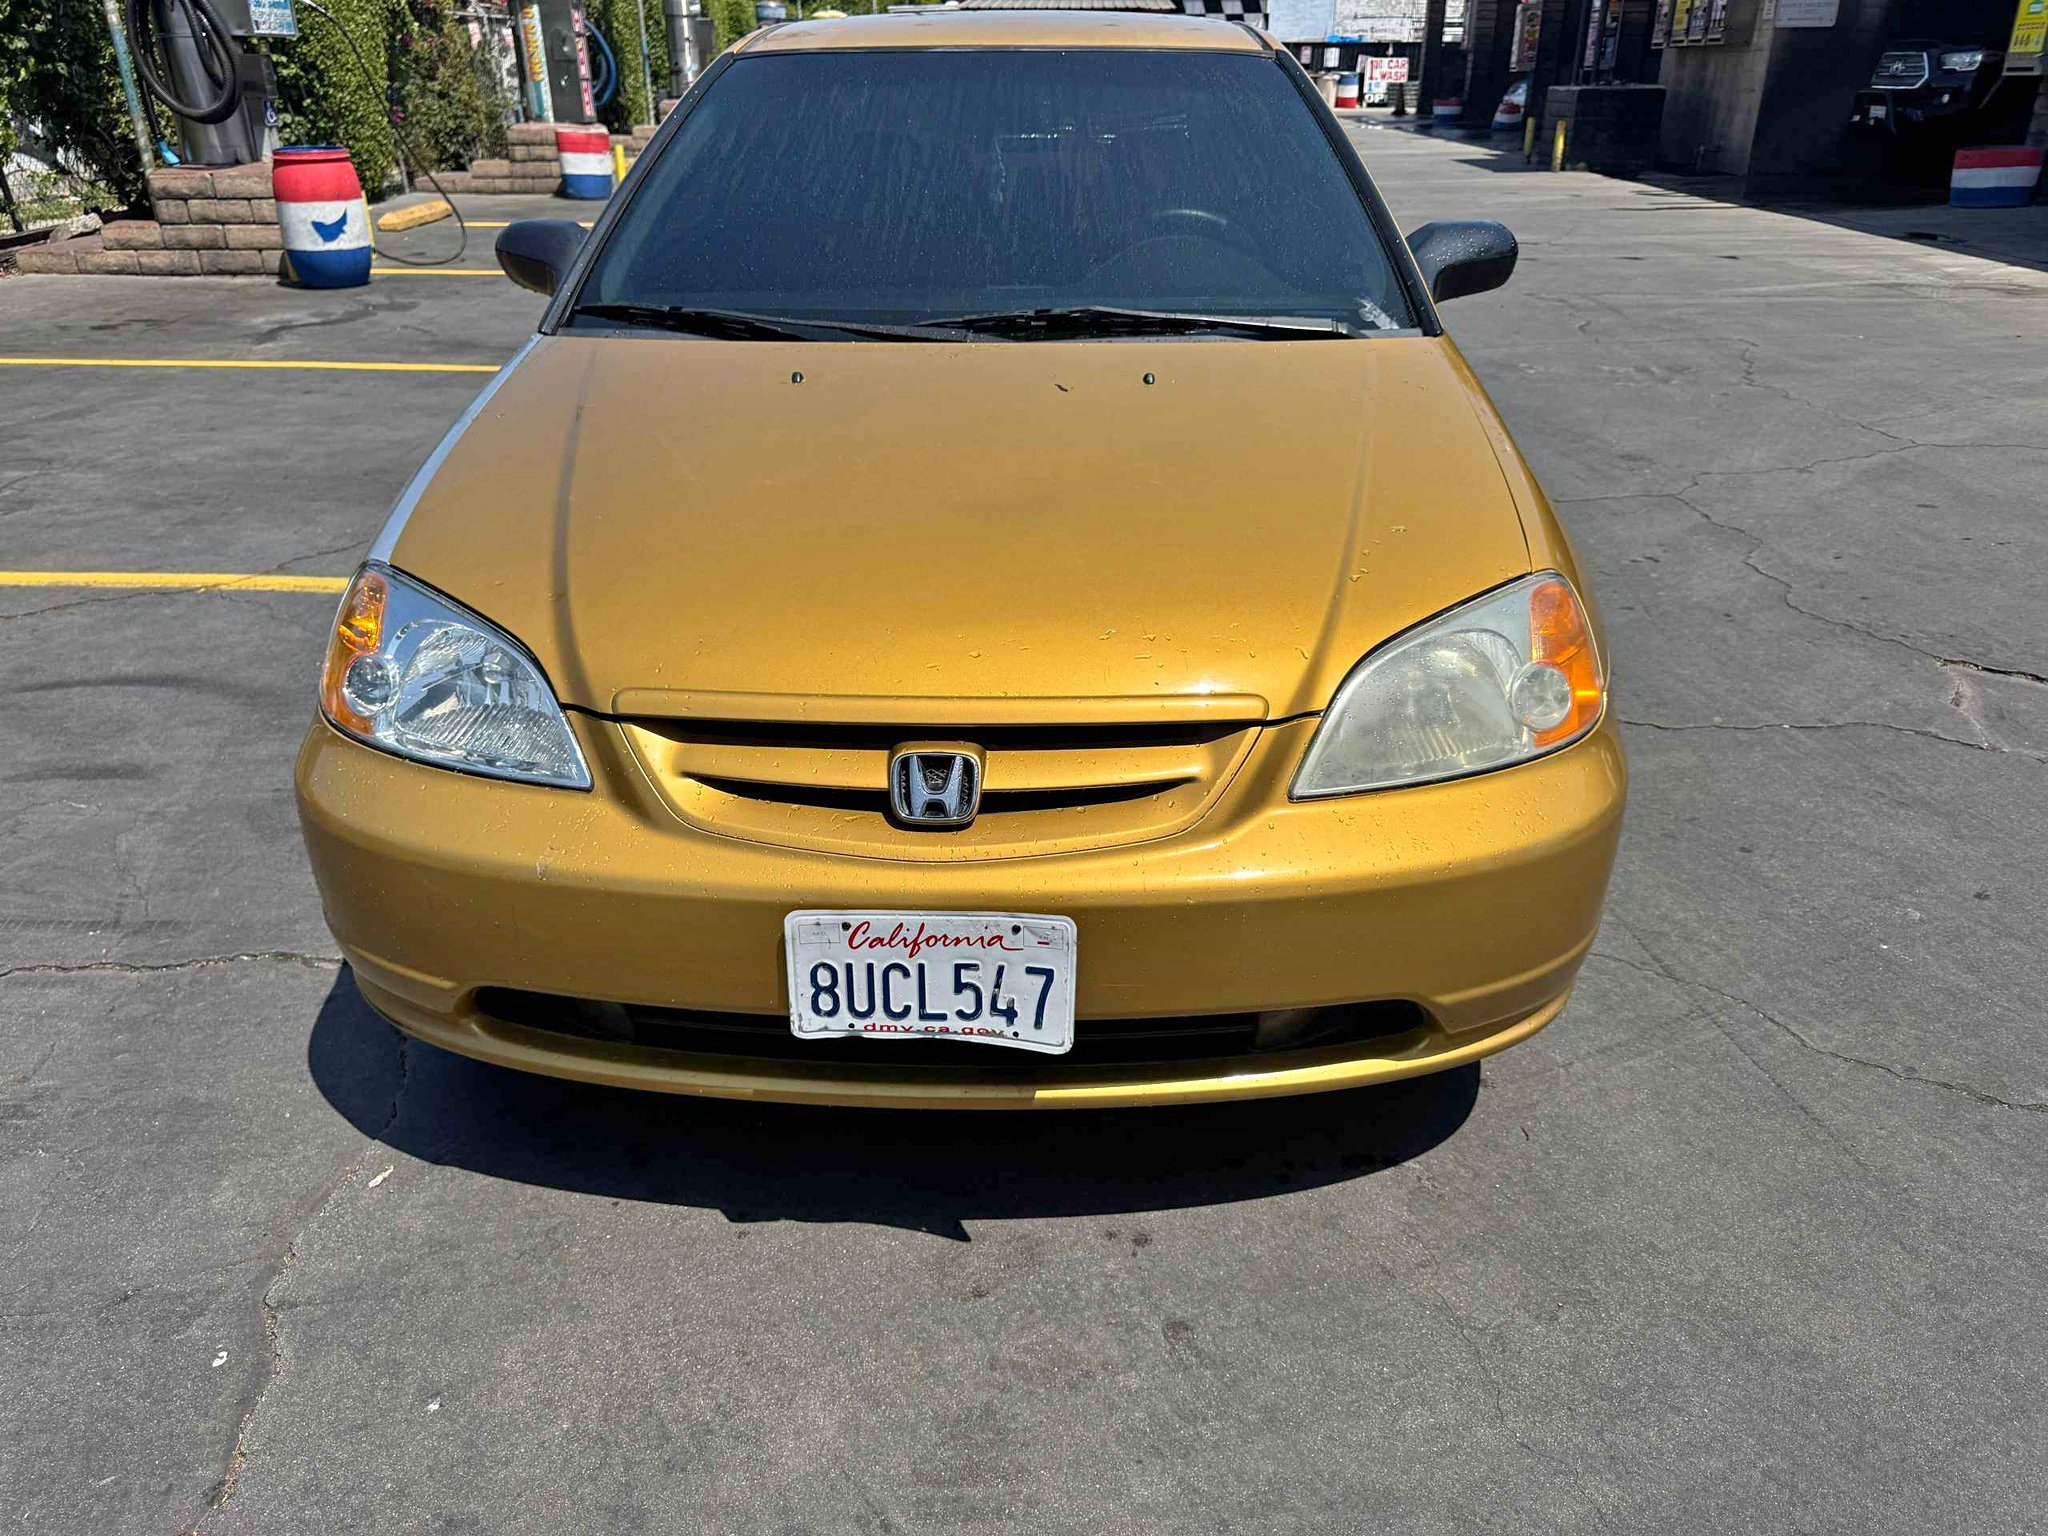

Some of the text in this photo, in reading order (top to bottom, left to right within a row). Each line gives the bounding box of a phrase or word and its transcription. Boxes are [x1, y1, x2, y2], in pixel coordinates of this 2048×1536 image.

[1388, 60, 1407, 69] CAR
[1380, 70, 1406, 81] WASH
[848, 921, 1024, 959] California
[810, 962, 1055, 1030] 8UCL547
[863, 1023, 1006, 1037] dmv.ca.gov
